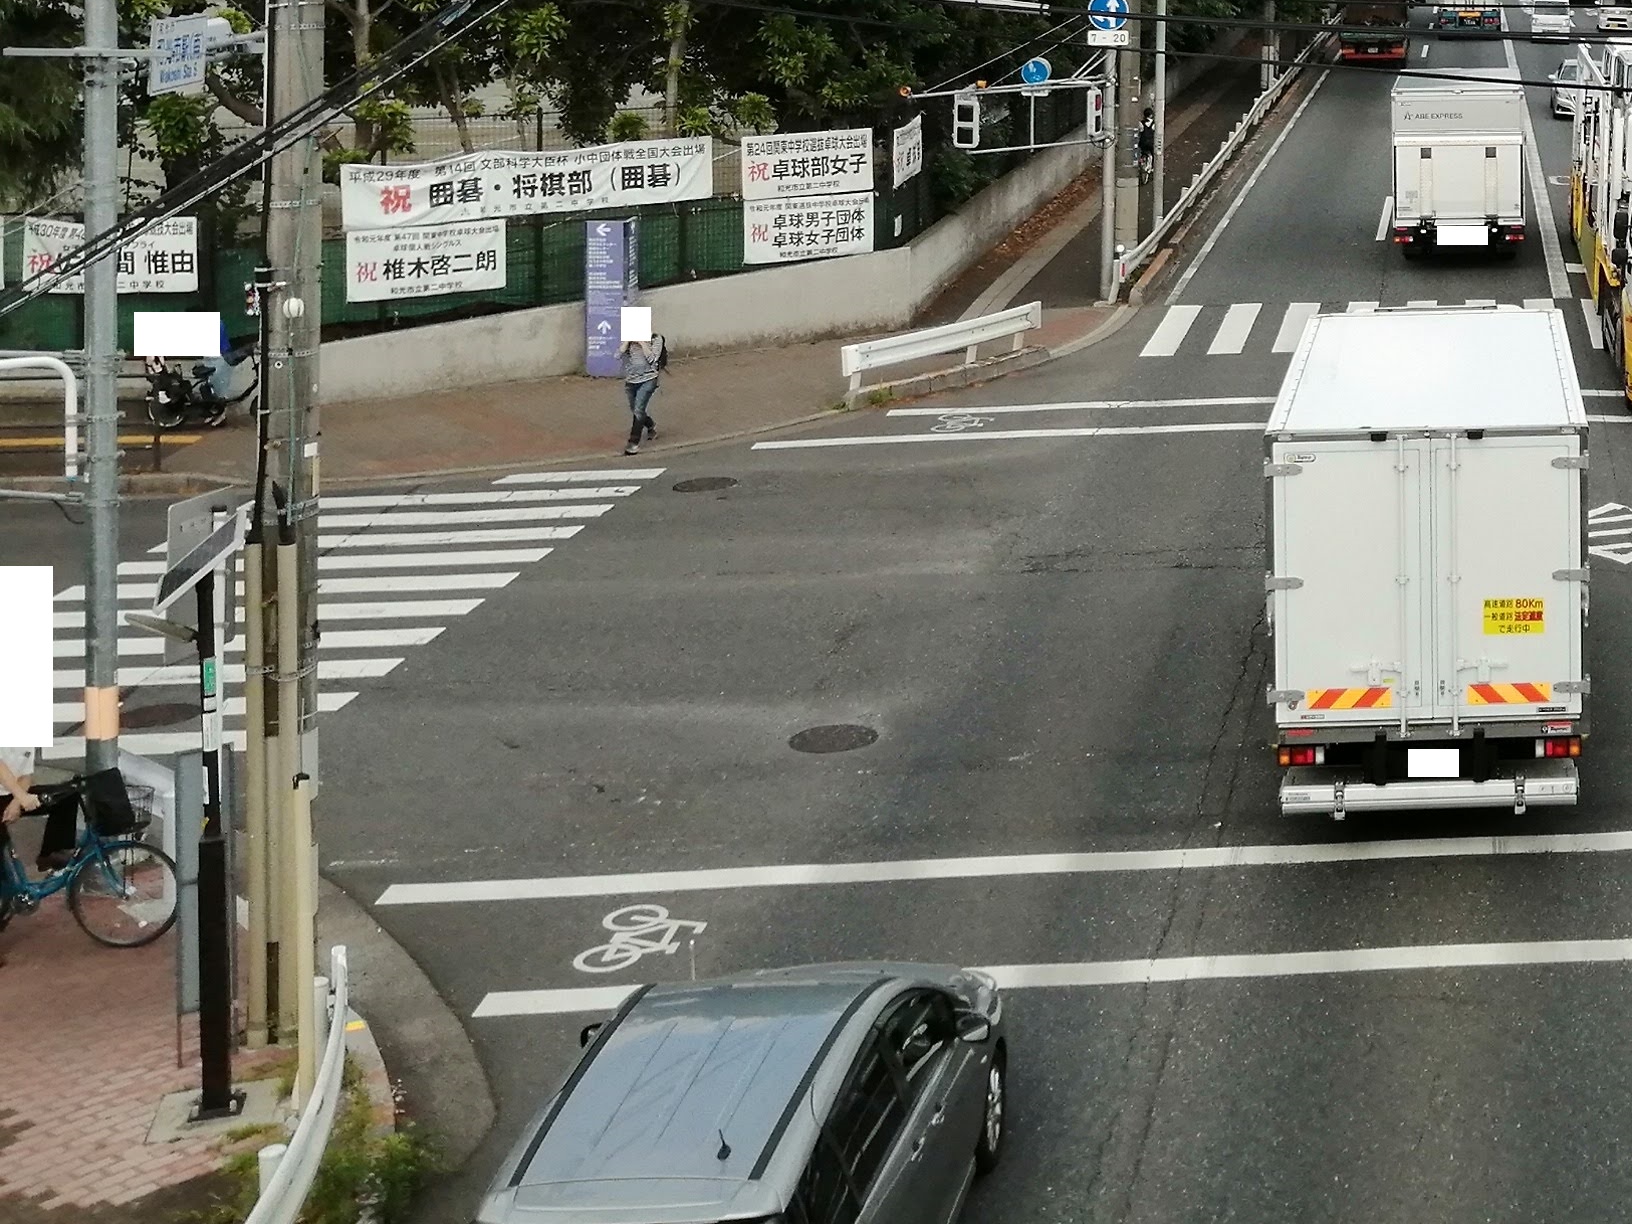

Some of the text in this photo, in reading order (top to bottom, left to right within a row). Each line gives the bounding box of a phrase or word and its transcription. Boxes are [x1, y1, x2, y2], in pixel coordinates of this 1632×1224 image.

[349, 168, 421, 183] 平成29年度
[748, 153, 867, 182] 祝 卓球部女子
[380, 184, 413, 215] 祝
[772, 208, 865, 230] 卓球男子団体
[751, 223, 865, 248] 祝 卓球女子団体
[356, 261, 378, 283] 祝
[1515, 599, 1544, 608] 80Km
